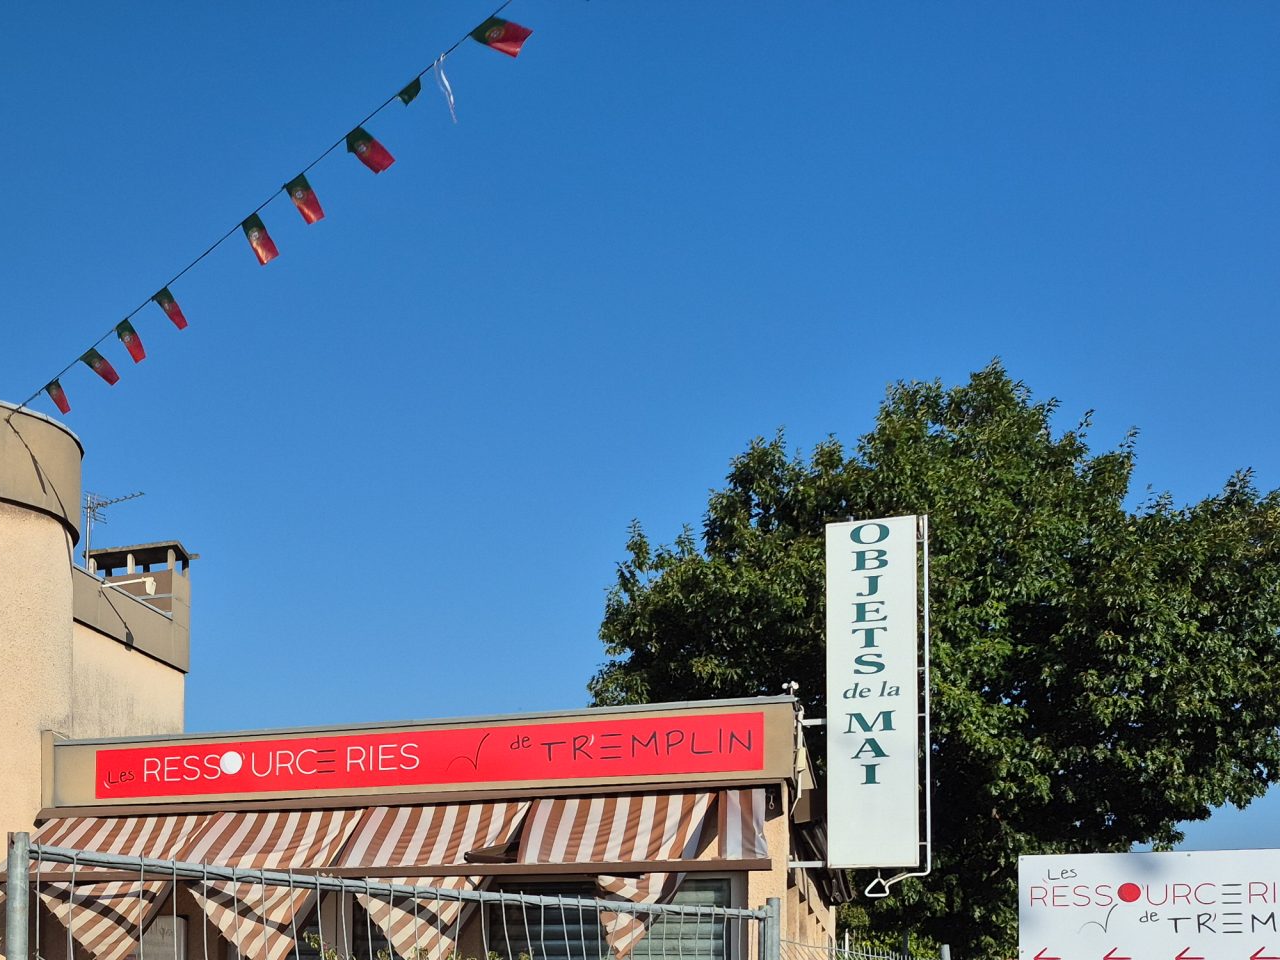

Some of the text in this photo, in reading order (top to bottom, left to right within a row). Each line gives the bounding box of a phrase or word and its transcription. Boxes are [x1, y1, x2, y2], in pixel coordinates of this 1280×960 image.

[849, 523, 890, 675] OBJETS
[843, 681, 901, 699] de la
[107, 769, 135, 784] Les
[509, 734, 532, 750] de
[540, 727, 752, 762] TREMPLIN
[843, 710, 896, 785] MAI
[1047, 867, 1078, 881] Les
[1139, 910, 1160, 923] de
